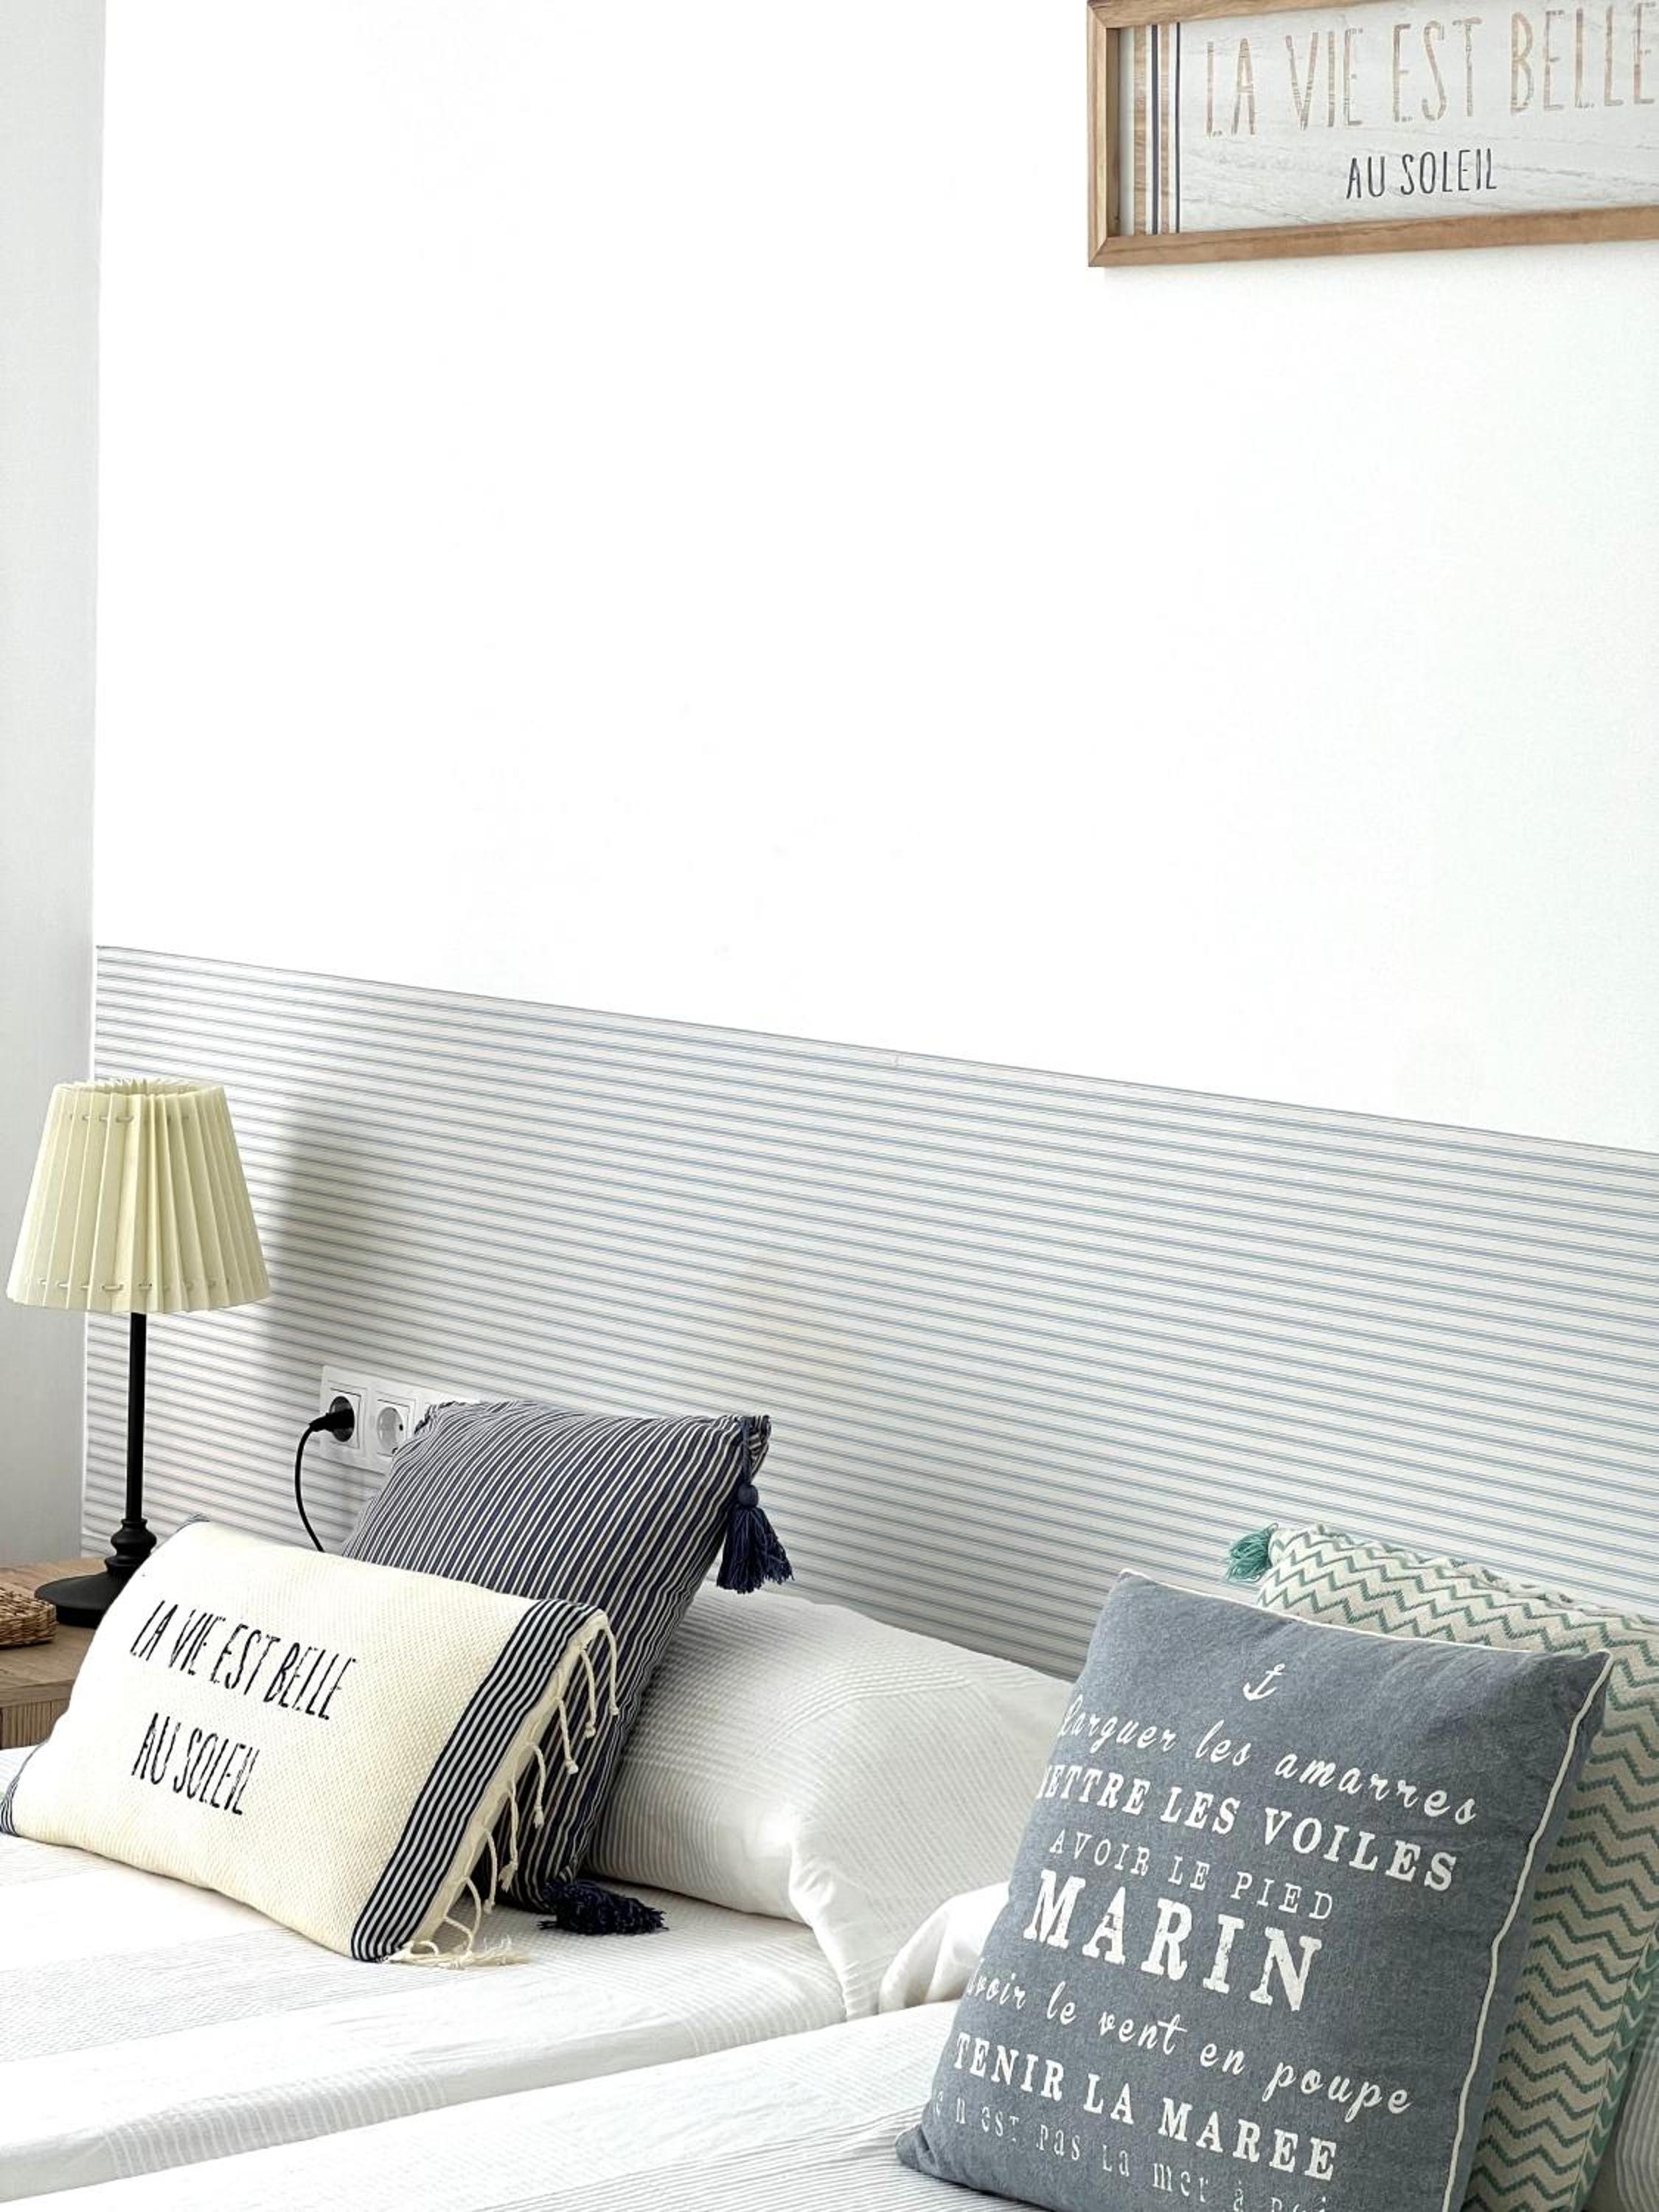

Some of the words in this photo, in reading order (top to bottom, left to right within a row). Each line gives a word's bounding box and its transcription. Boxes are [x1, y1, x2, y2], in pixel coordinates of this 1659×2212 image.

[1205, 37, 1255, 139] LA
[1285, 27, 1363, 131] VIE
[1393, 16, 1481, 122] EST
[1510, 1, 1657, 115] BELLE
[1346, 156, 1385, 199] AU
[1401, 148, 1498, 196] SOLEIL
[130, 1600, 178, 1661] LA
[168, 1608, 226, 1676] VIE
[209, 1623, 281, 1696] EST
[262, 1641, 358, 1720] BELLE
[131, 1712, 181, 1785] AU
[173, 1728, 260, 1815] SOLEIL
[1195, 1719, 1251, 1766] les
[1274, 1750, 1478, 1826] amarres
[1049, 1828, 1150, 1877] AVOIR
[1167, 1857, 1211, 1891] LE
[1230, 1871, 1334, 1921] PIED
[1160, 1786, 1241, 1834] LES
[1264, 1808, 1458, 1891] VOILES
[1023, 1869, 1324, 2012] MARIN
[953, 2031, 1064, 2101] TENIR
[1083, 2073, 1135, 2124] LA
[1158, 2096, 1338, 2183] MAREE
[1046, 1980, 1077, 2025] le
[1098, 2011, 1186, 2057] vent
[1200, 2043, 1245, 2076] en
[1262, 2064, 1413, 2124] poupe
